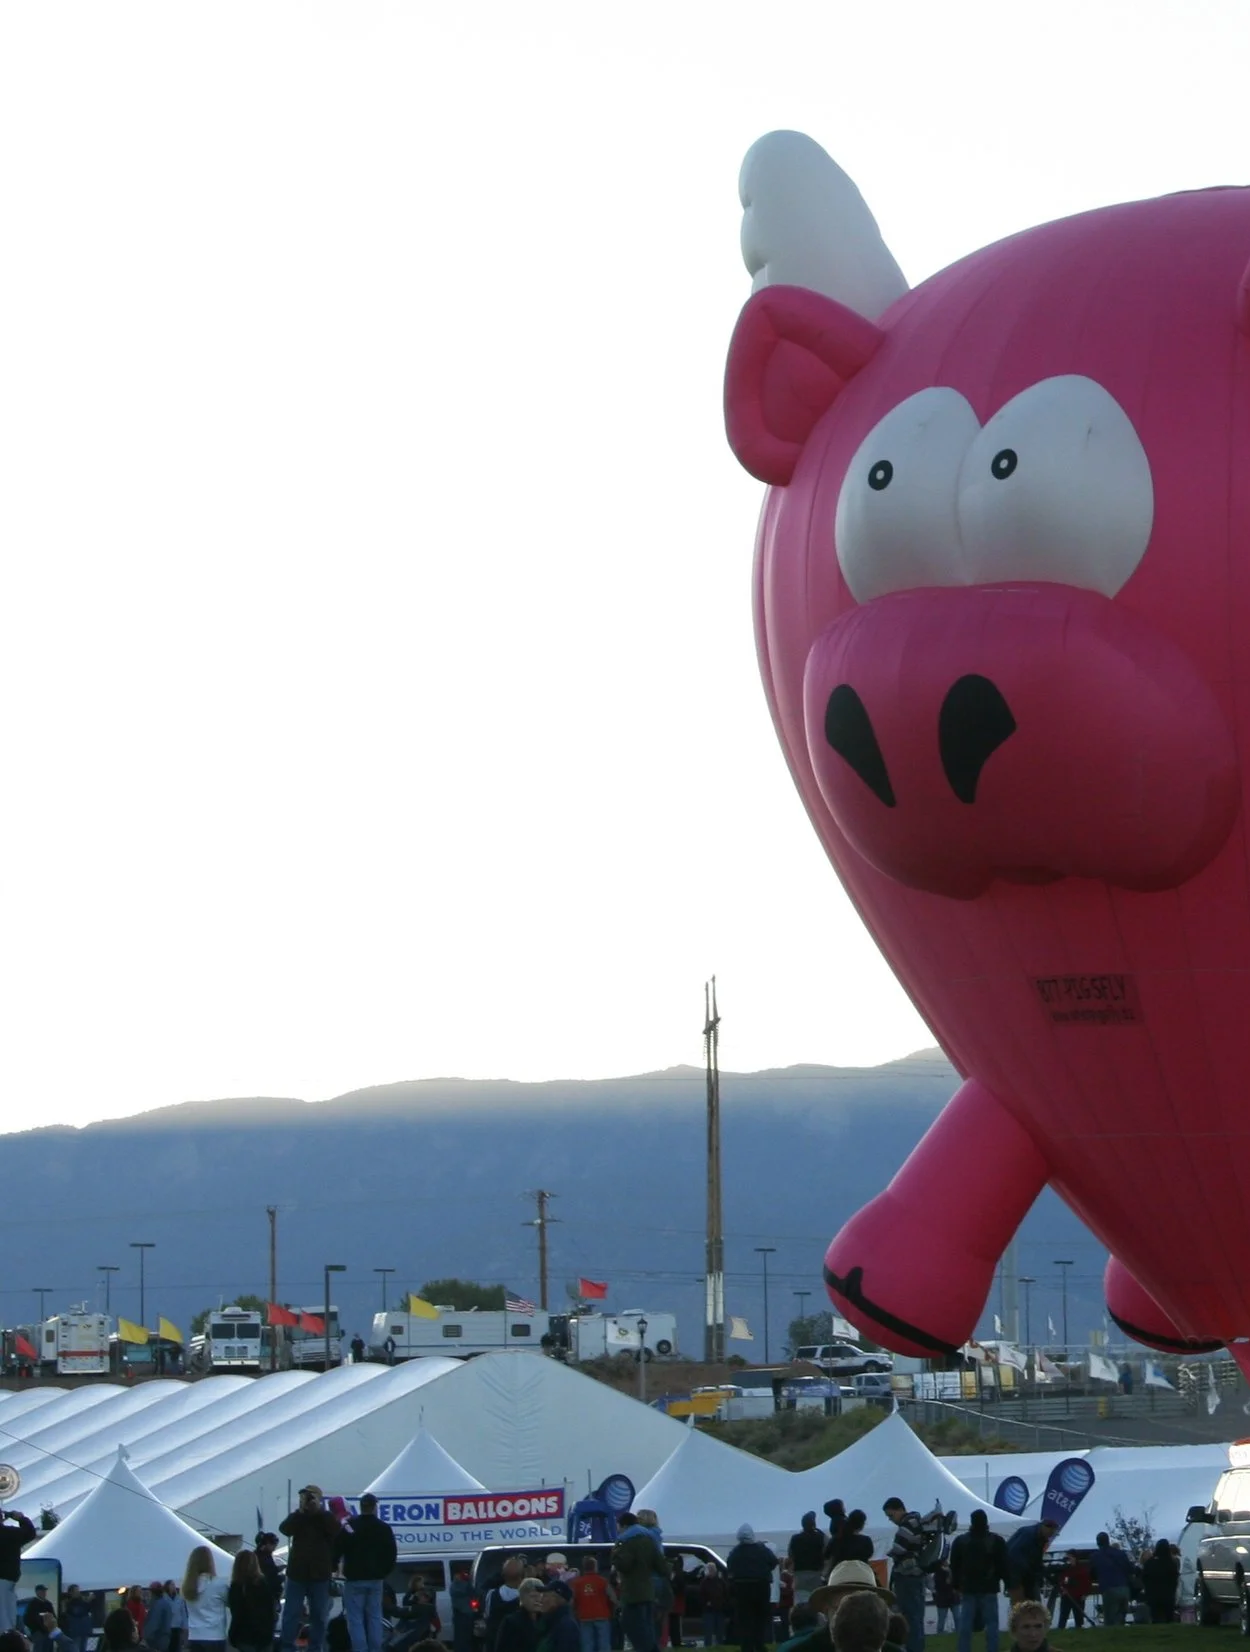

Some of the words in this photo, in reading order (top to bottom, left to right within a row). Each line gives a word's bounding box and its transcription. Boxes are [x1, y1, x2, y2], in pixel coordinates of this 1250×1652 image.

[446, 1495, 560, 1521] BALLOONS
[1047, 1488, 1077, 1513] at&t
[462, 1529, 494, 1541] THE
[499, 1525, 562, 1540] WORLD
